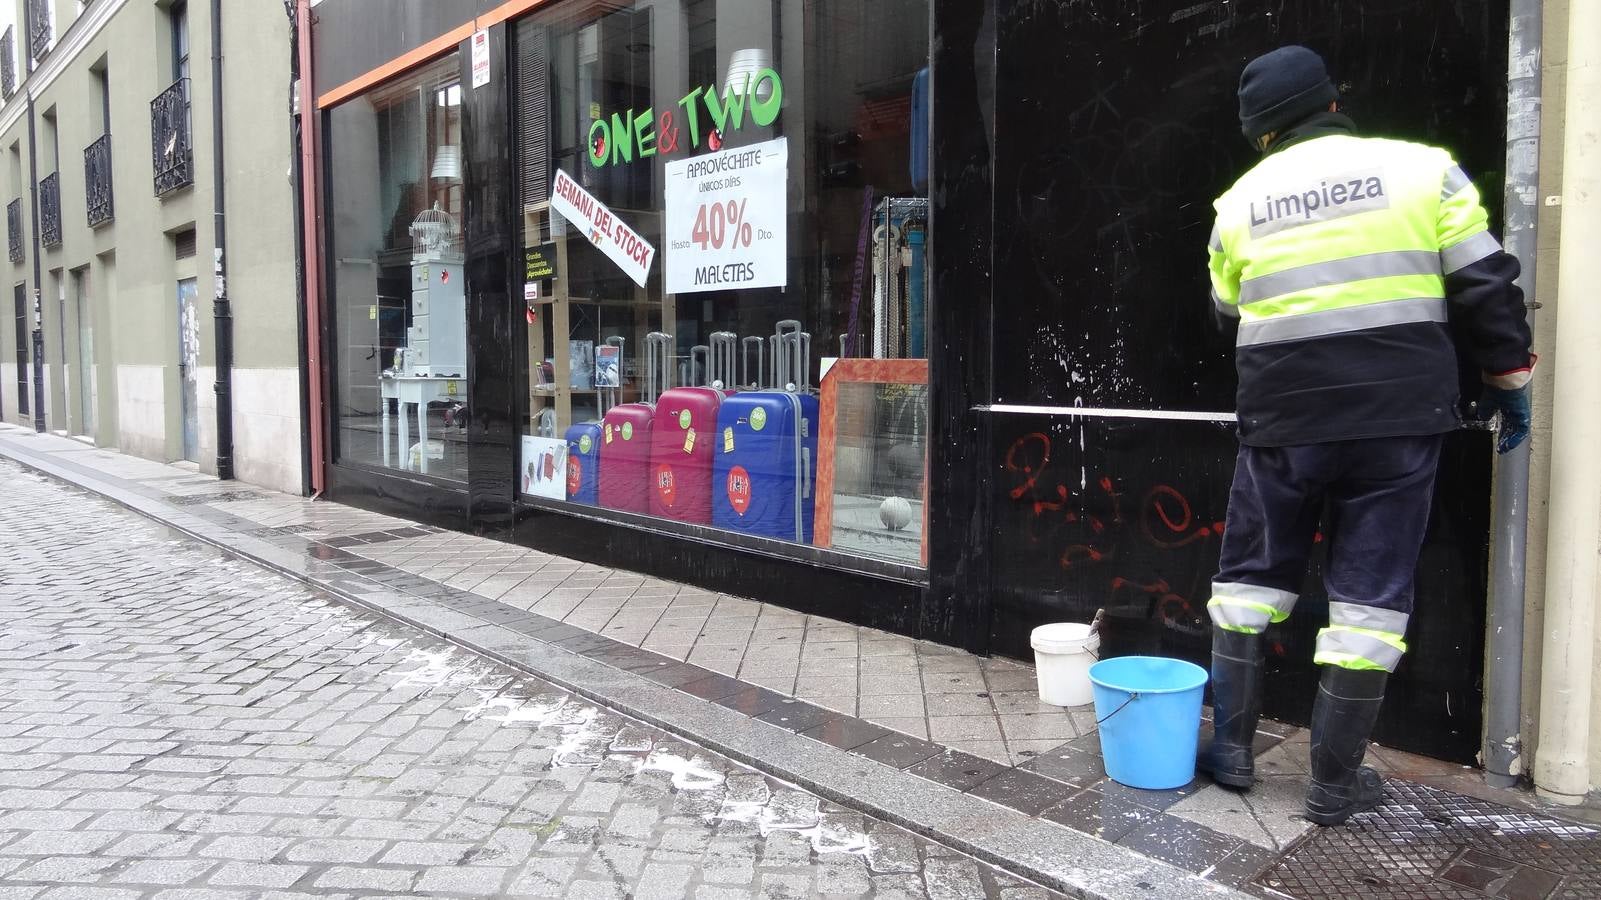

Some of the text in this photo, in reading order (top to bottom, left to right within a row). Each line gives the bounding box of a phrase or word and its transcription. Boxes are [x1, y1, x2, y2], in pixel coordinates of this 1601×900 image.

[588, 67, 784, 167] ONE & TWO
[687, 149, 762, 179] APROVÉCHATE
[724, 175, 742, 189] DÍAS
[556, 174, 650, 270] SEMANA DEL STOCK
[671, 198, 774, 251] Hasta 40% Dto.
[1250, 176, 1384, 227] Limpieza
[694, 262, 755, 286] MALETAS
